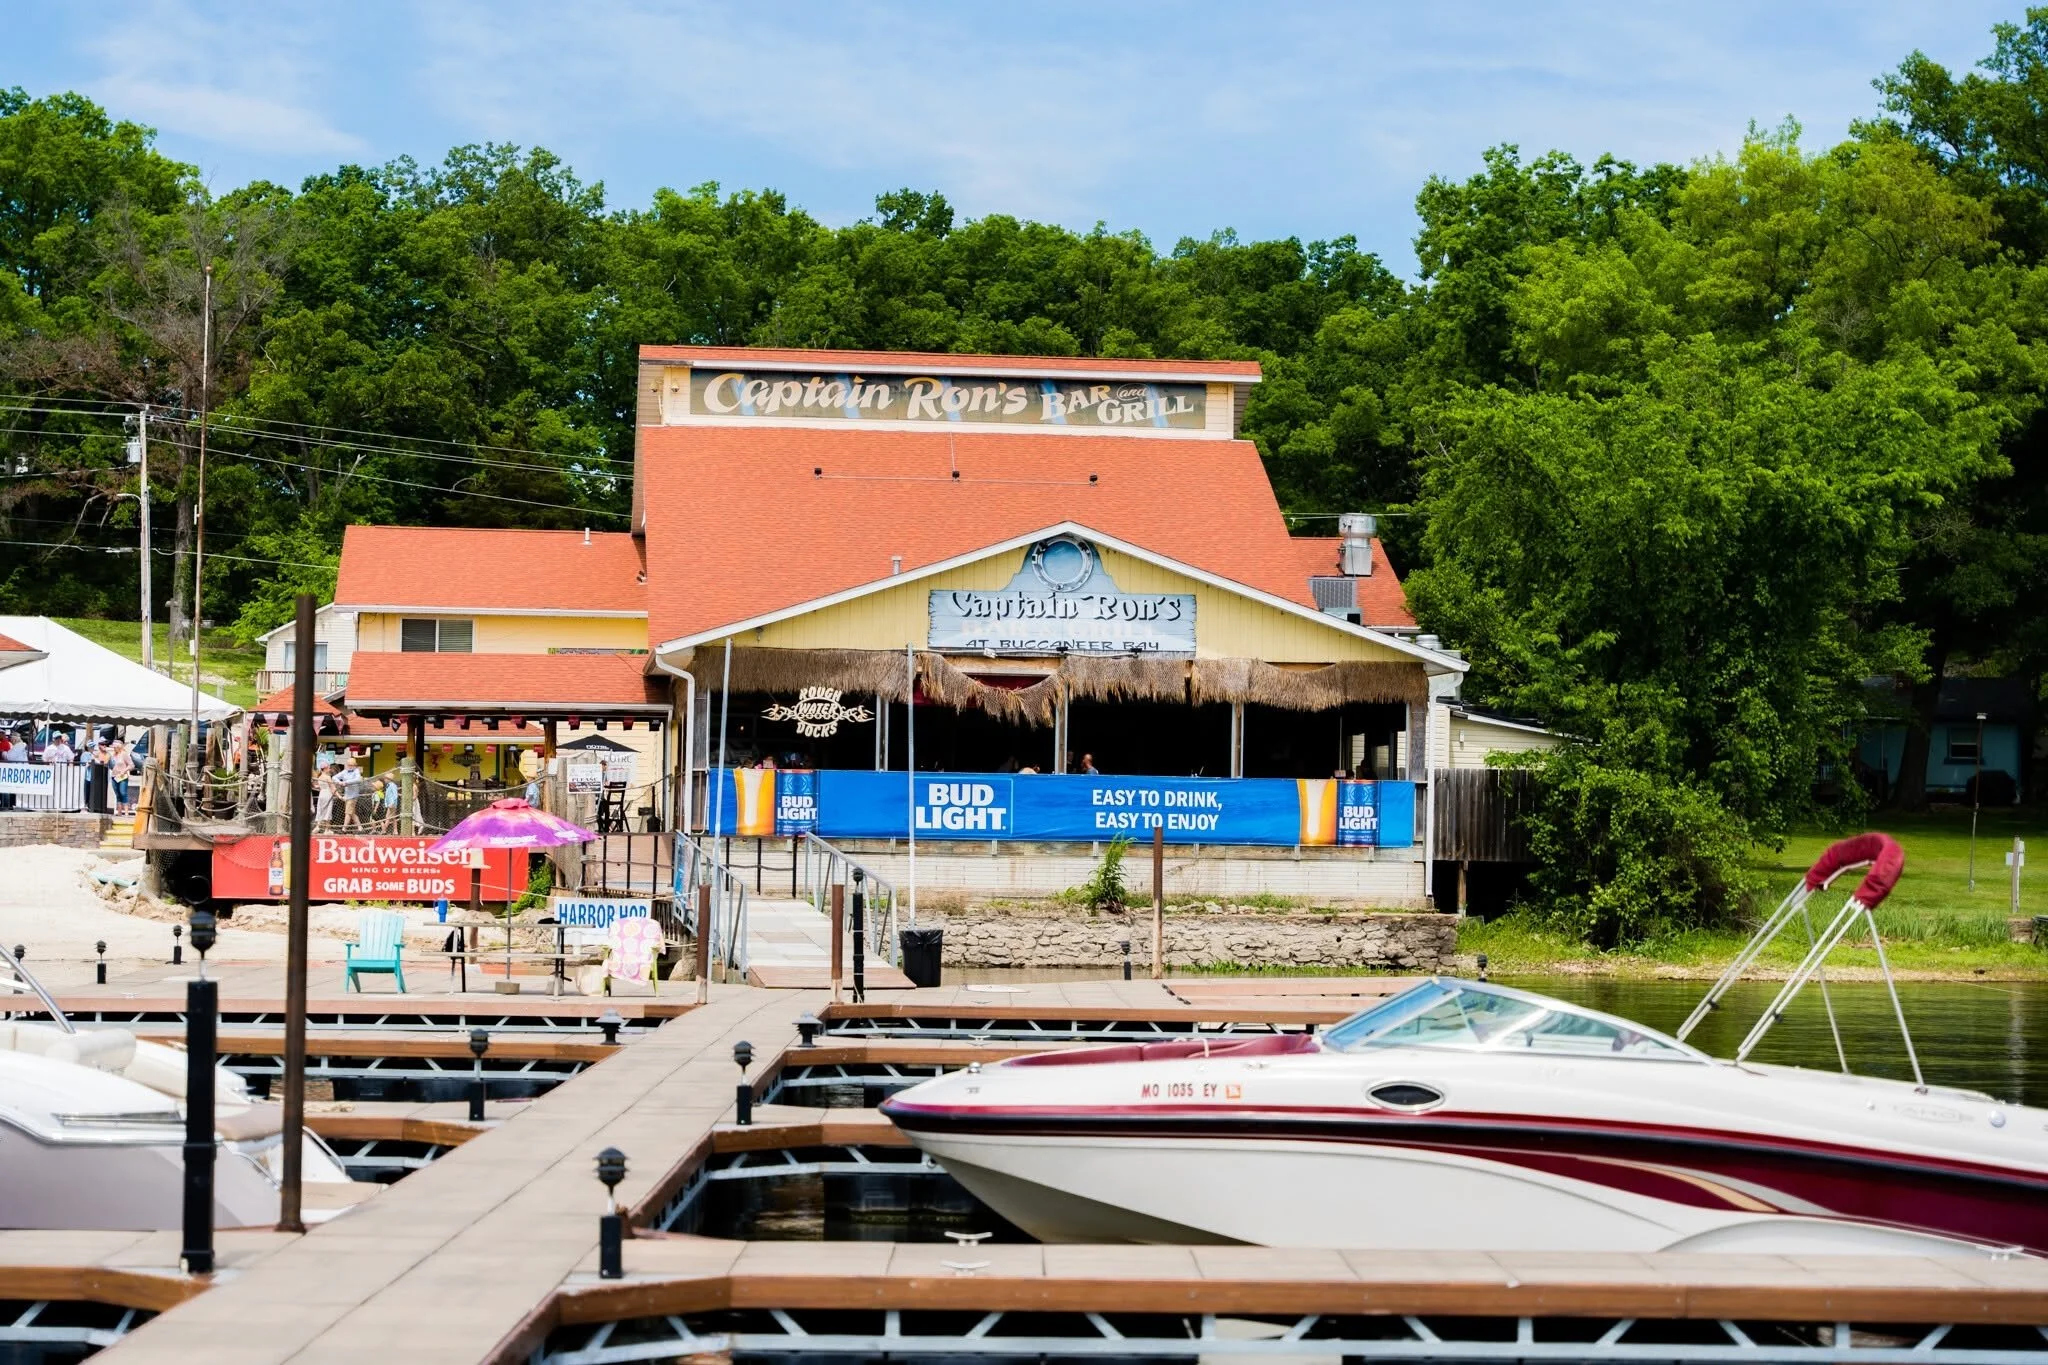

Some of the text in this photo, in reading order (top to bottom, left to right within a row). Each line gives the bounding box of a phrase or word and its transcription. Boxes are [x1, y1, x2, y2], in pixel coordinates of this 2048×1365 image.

[703, 372, 1147, 421] Captain Ron's BAR and
[1097, 394, 1194, 424] GRILL
[952, 591, 1181, 621] Captain Ron's
[965, 640, 986, 648] AT
[1000, 639, 1113, 650] BUCCANEER
[799, 686, 842, 701] ROUGH
[799, 702, 838, 714] WATER
[796, 721, 838, 738] DOCKS
[33, 769, 51, 784] HOP
[781, 795, 814, 808] BUD
[928, 783, 994, 806] BUD
[1092, 789, 1222, 811] EASY TO DRINK,
[777, 807, 817, 820] LIGHT
[1343, 805, 1374, 818] BUD
[1095, 812, 1219, 831] EASY TO ENJOY
[1339, 817, 1378, 830] LIGHT
[315, 838, 472, 866] Budweiser
[324, 877, 455, 895] GRAB SOME BUDS
[559, 903, 615, 928] HARBOR
[1141, 1084, 1159, 1098] MO
[1167, 1083, 1194, 1098] 1035
[1203, 1083, 1217, 1097] EY
